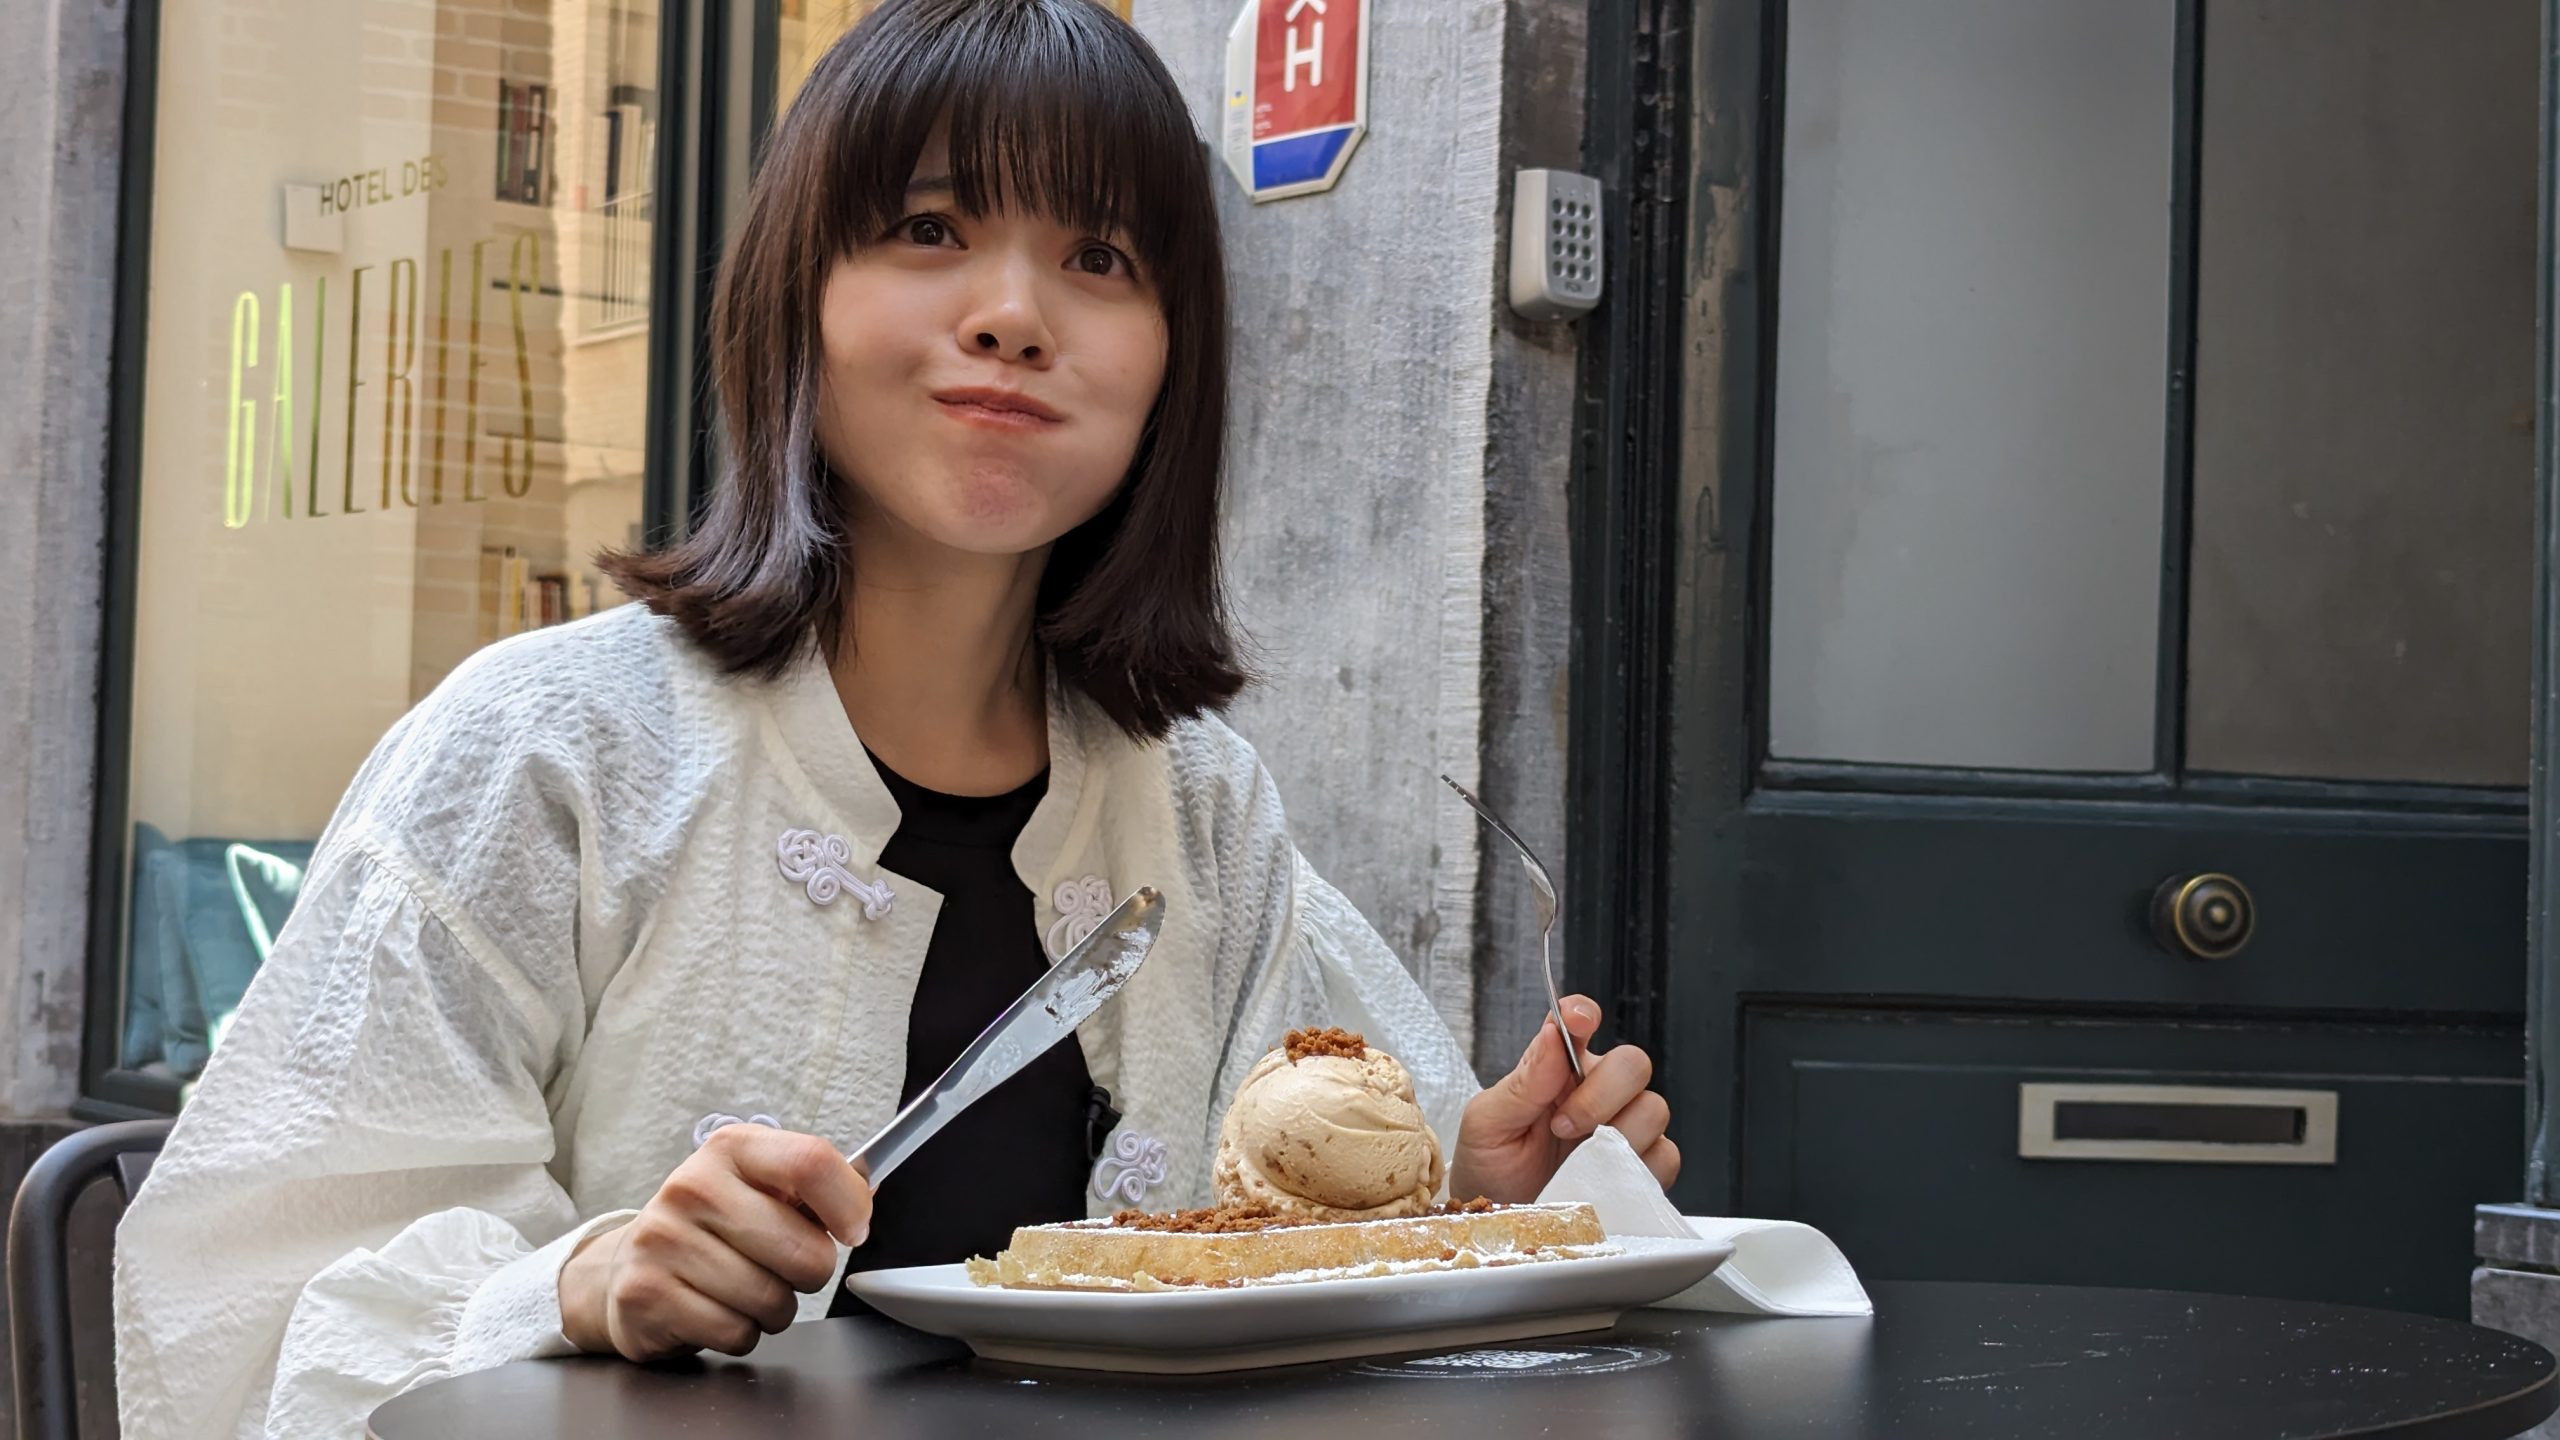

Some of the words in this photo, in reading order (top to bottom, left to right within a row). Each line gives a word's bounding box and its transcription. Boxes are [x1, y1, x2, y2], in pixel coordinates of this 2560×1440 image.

[1284, 21, 1324, 92] H
[320, 168, 393, 216] HOTEL
[402, 154, 448, 196] DES
[224, 230, 540, 529] GALERIES
